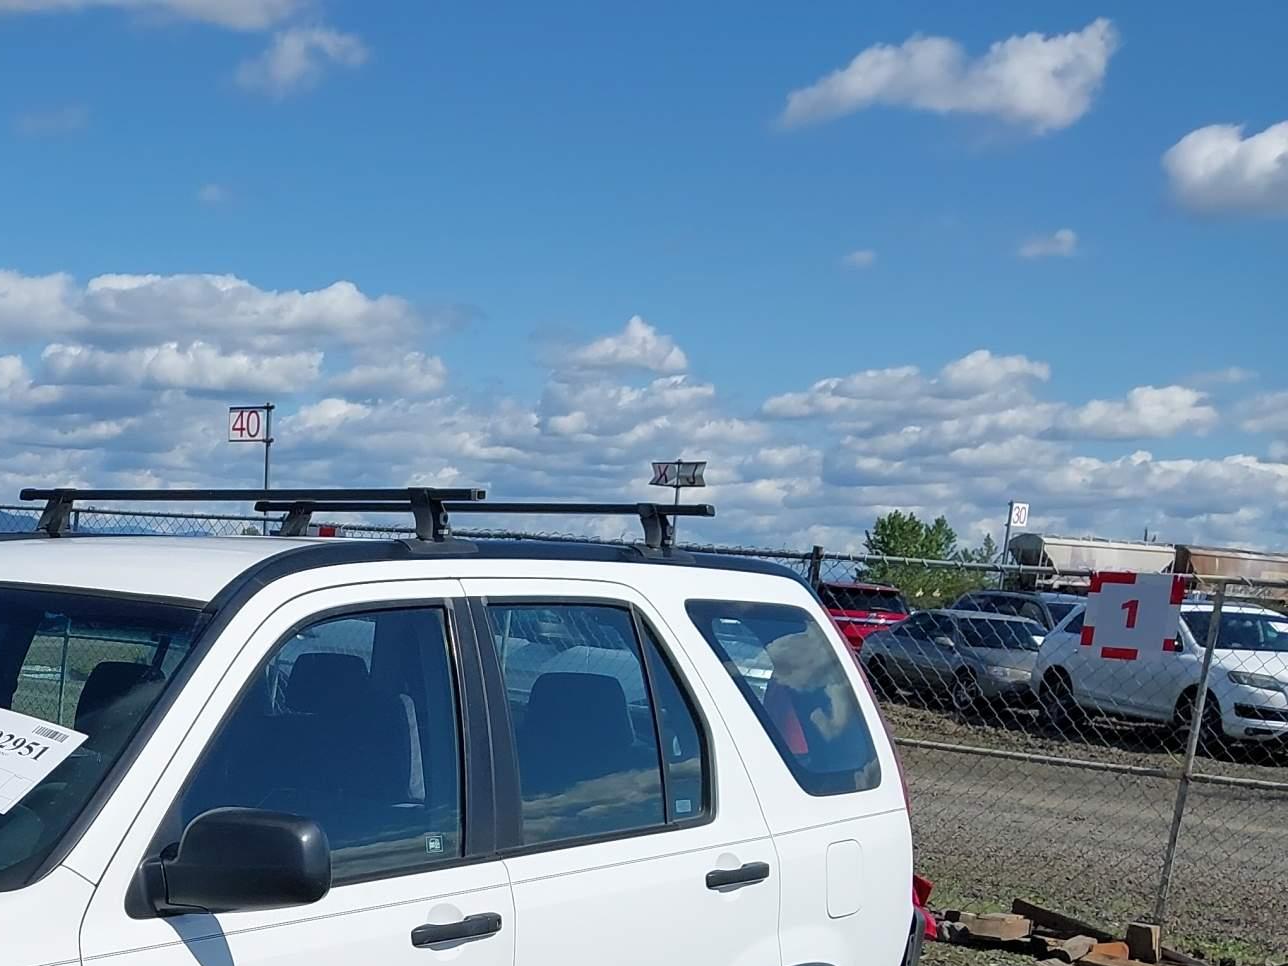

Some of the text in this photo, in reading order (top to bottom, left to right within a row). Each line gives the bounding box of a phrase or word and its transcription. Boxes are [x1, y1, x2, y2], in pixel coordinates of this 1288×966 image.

[232, 410, 260, 438] 40
[655, 463, 698, 485] X J
[1012, 505, 1027, 525] 30
[1121, 599, 1139, 629] 1
